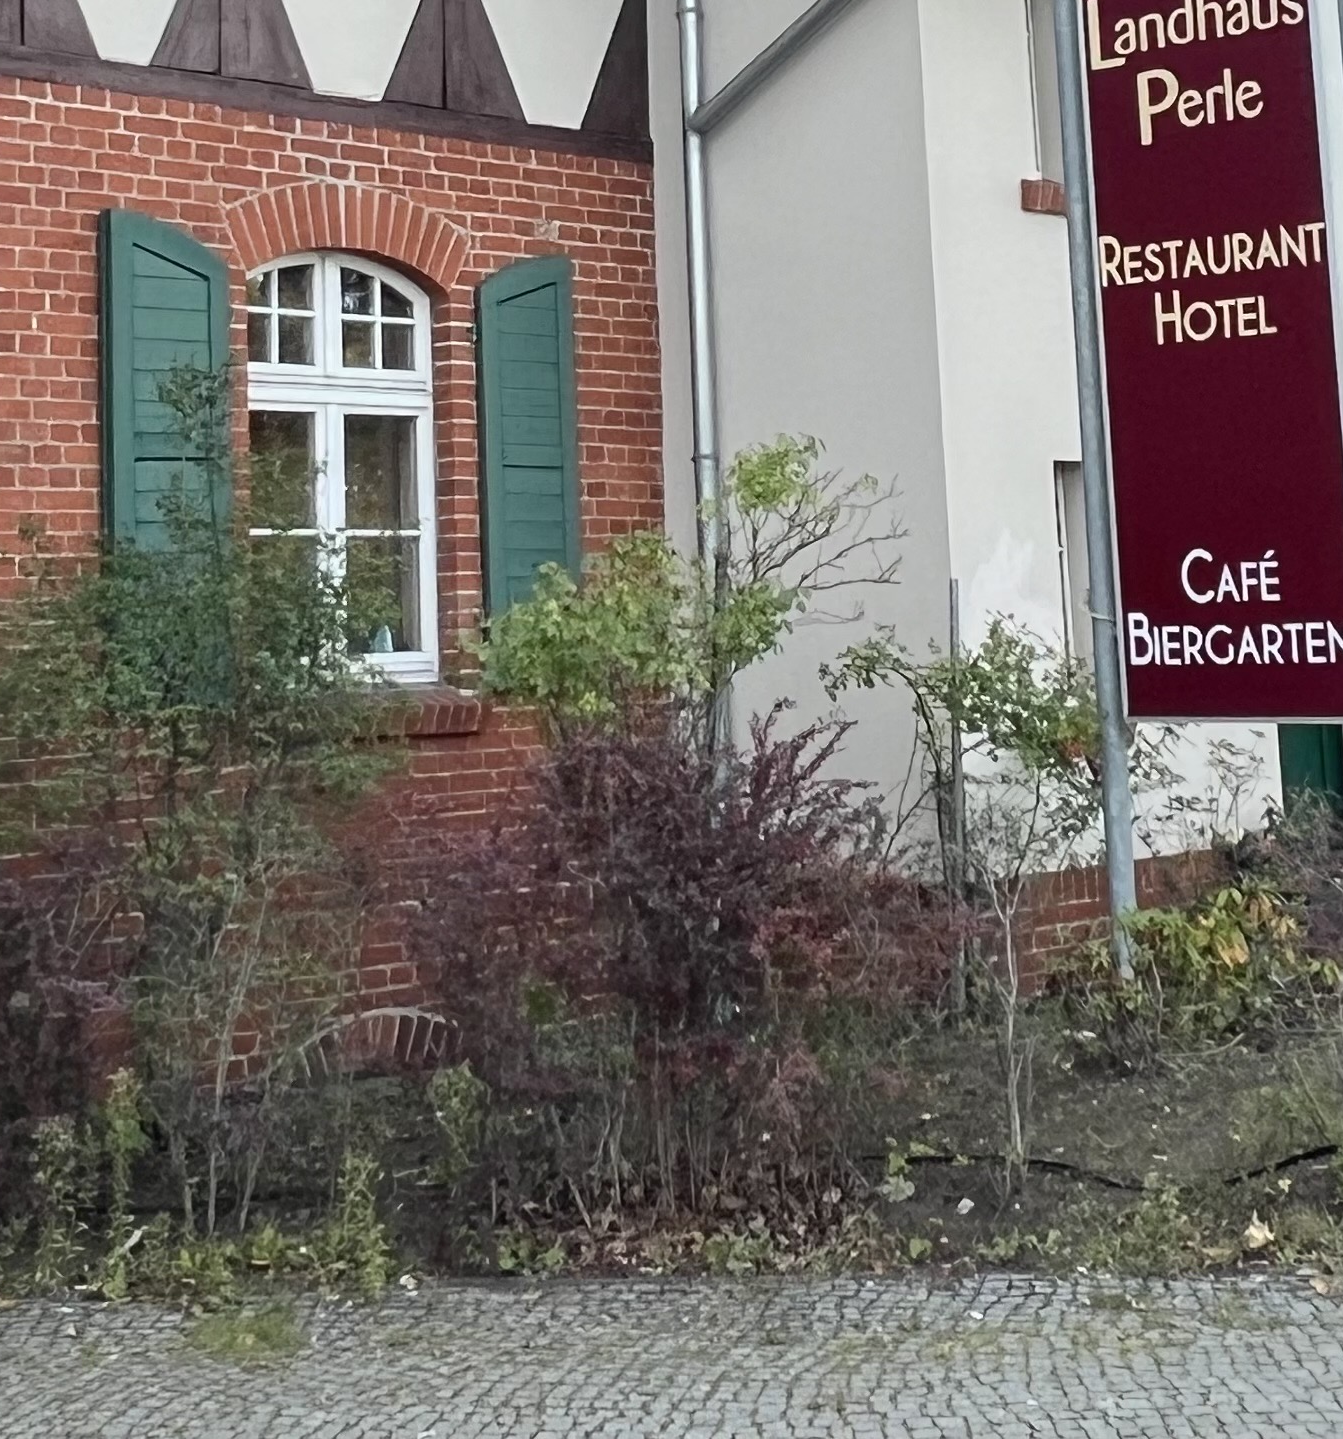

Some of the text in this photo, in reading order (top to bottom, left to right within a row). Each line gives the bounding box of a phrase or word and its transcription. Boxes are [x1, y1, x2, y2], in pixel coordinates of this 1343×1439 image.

[1135, 67, 1264, 146] Perle
[1098, 222, 1326, 287] RESTAURANT
[1153, 289, 1278, 346] HOTEL
[1181, 548, 1281, 604] CAFÉ
